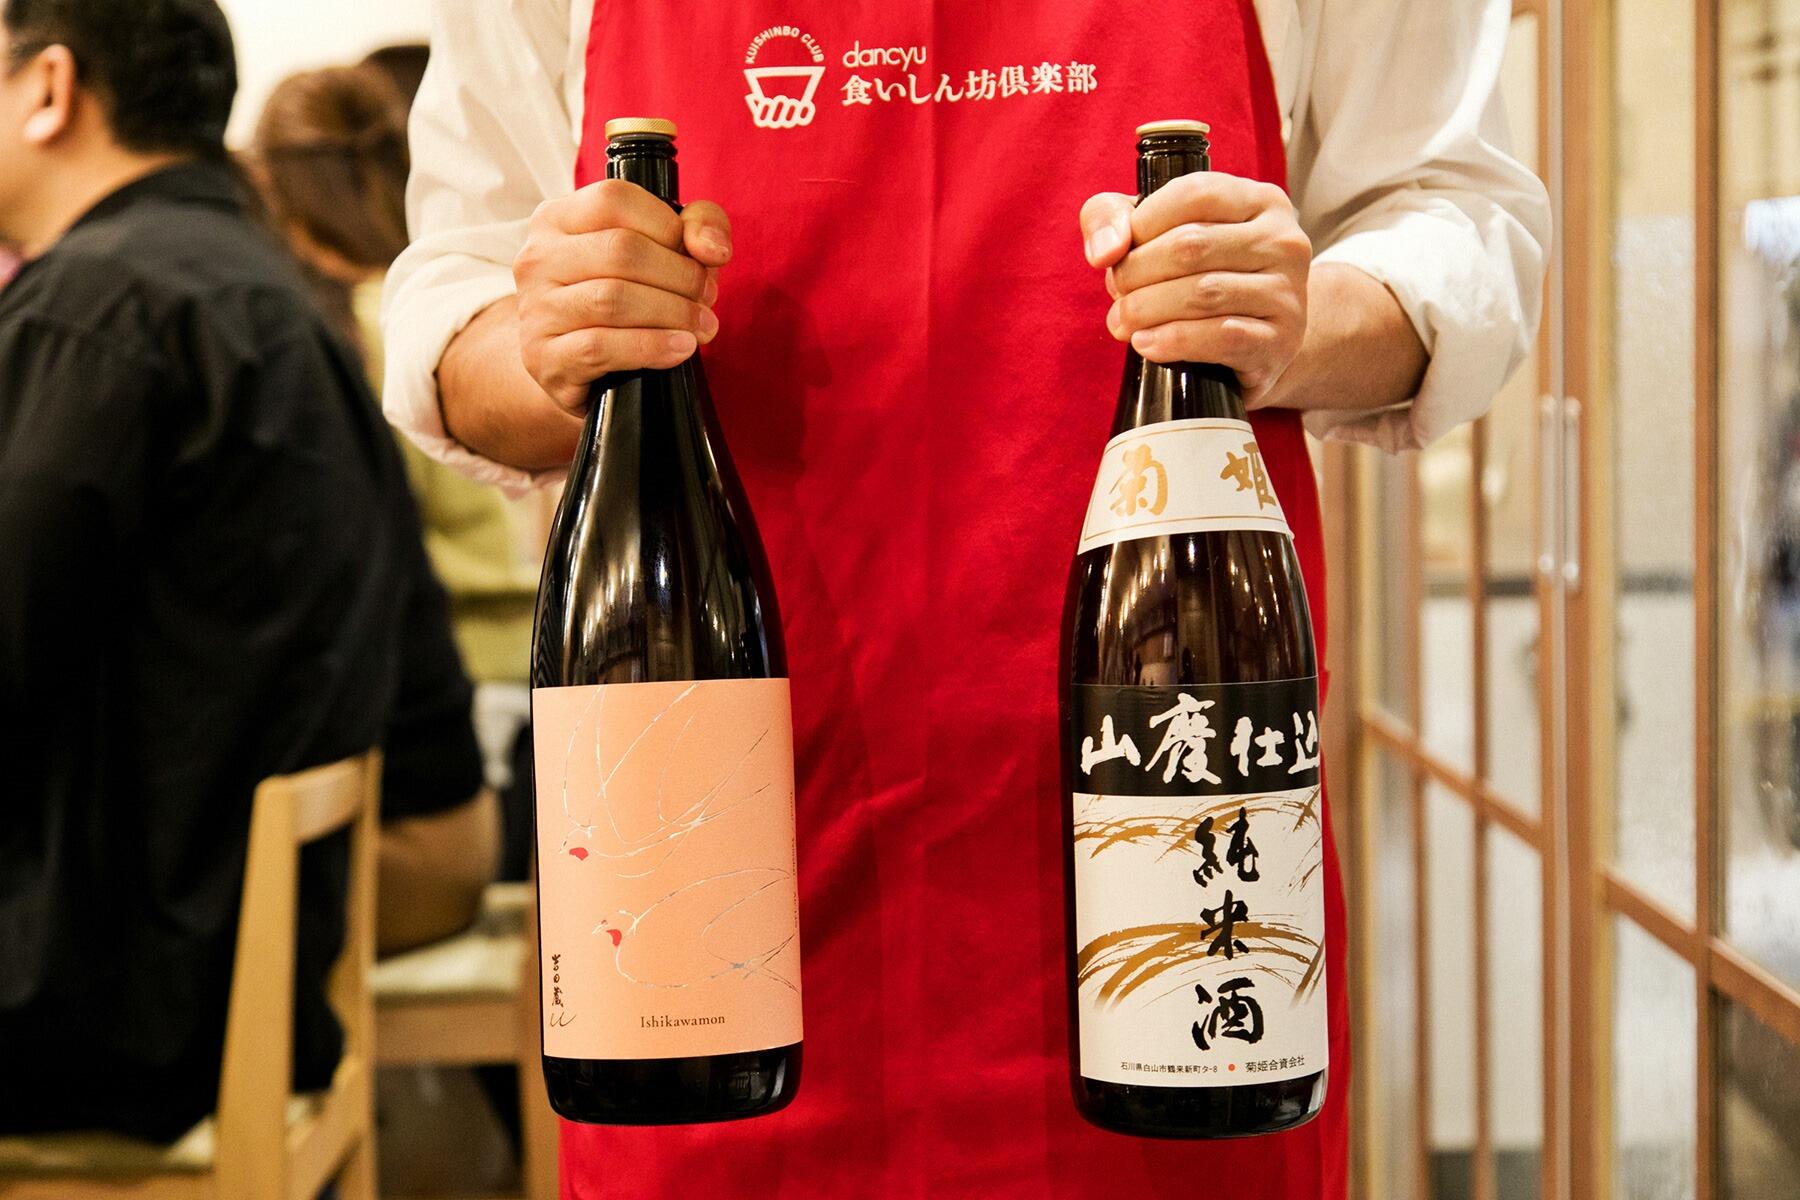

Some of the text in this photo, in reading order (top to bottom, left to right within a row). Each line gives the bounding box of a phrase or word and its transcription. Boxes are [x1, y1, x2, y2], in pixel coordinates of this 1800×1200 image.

[744, 26, 824, 64] KUISHINBO CLUB
[842, 40, 927, 71] dancyu
[840, 61, 1097, 106] 食いしん坊倶楽部
[1191, 806, 1264, 1051] 純米酒
[640, 1013, 726, 1029] Ishikawamon
[1245, 1056, 1306, 1073] 菊姫合資会社
